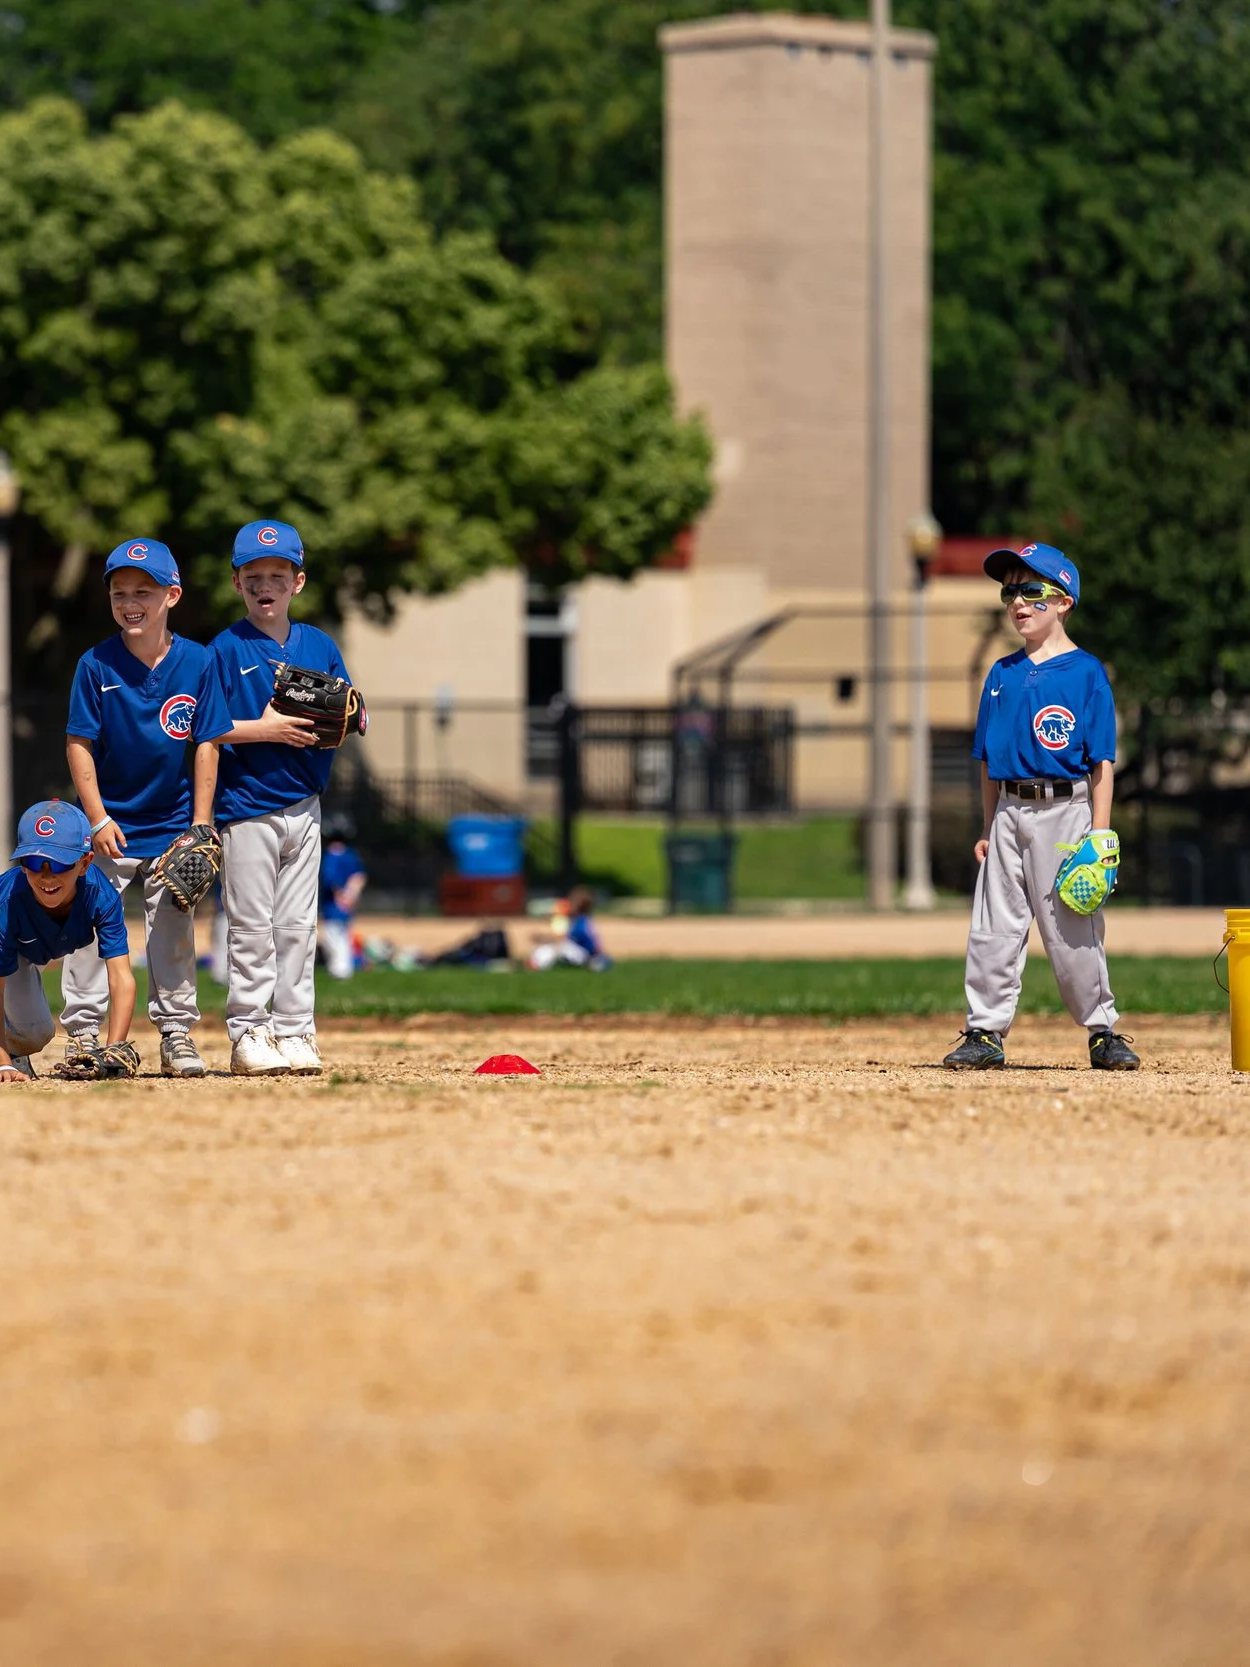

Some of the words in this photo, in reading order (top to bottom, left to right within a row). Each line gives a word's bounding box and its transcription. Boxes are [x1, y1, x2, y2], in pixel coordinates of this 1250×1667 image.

[257, 527, 278, 546] C
[127, 543, 148, 560] C
[286, 688, 316, 702] Rawlings
[35, 815, 56, 837] C
